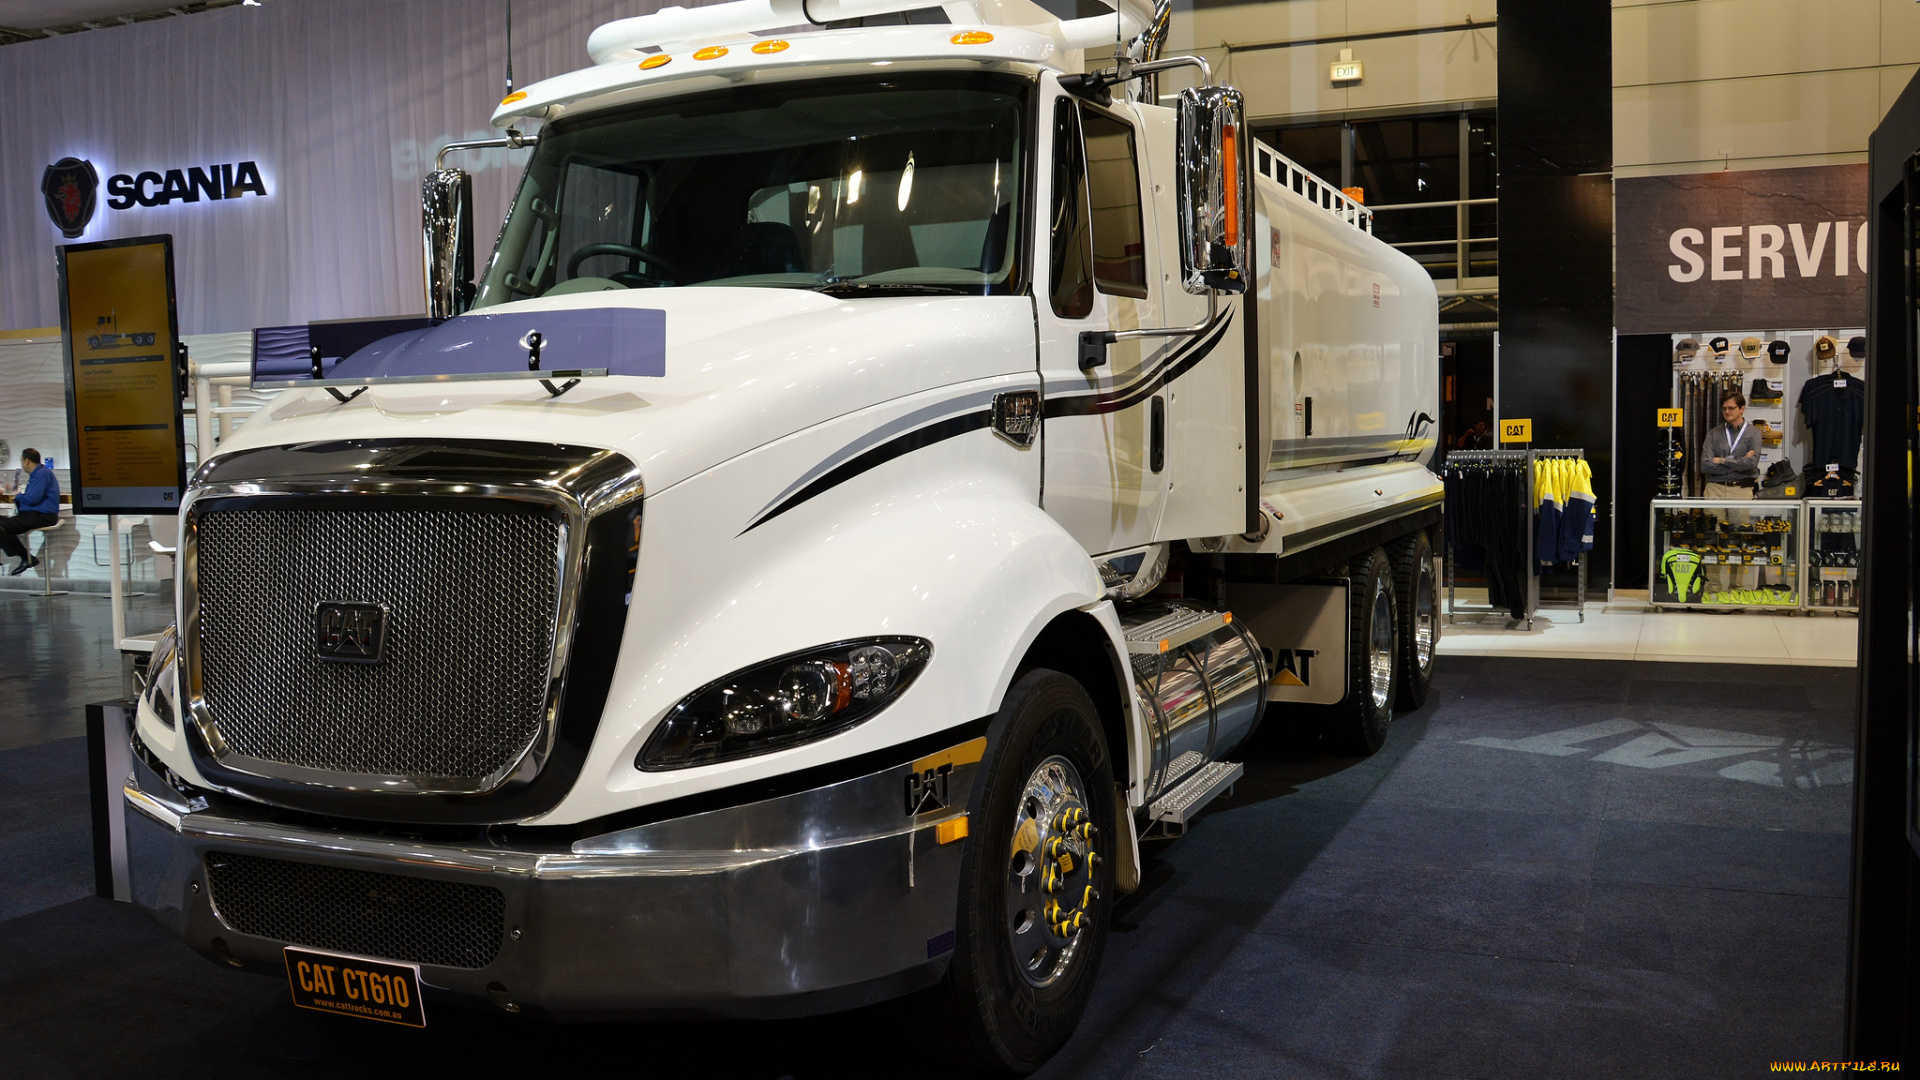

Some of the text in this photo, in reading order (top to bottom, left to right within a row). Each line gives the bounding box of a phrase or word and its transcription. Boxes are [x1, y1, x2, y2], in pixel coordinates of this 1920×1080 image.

[1336, 66, 1354, 77] EXIT
[107, 161, 268, 211] SCANIA
[1662, 413, 1678, 423] CAT
[1506, 425, 1525, 436] CAT
[163, 491, 174, 501] CAT
[1675, 563, 1691, 573] CAT
[321, 608, 378, 656] CAT
[903, 761, 954, 818] CAT
[297, 961, 410, 1008] CAT CT610
[314, 997, 402, 1019] www.cattrucks.com.au
